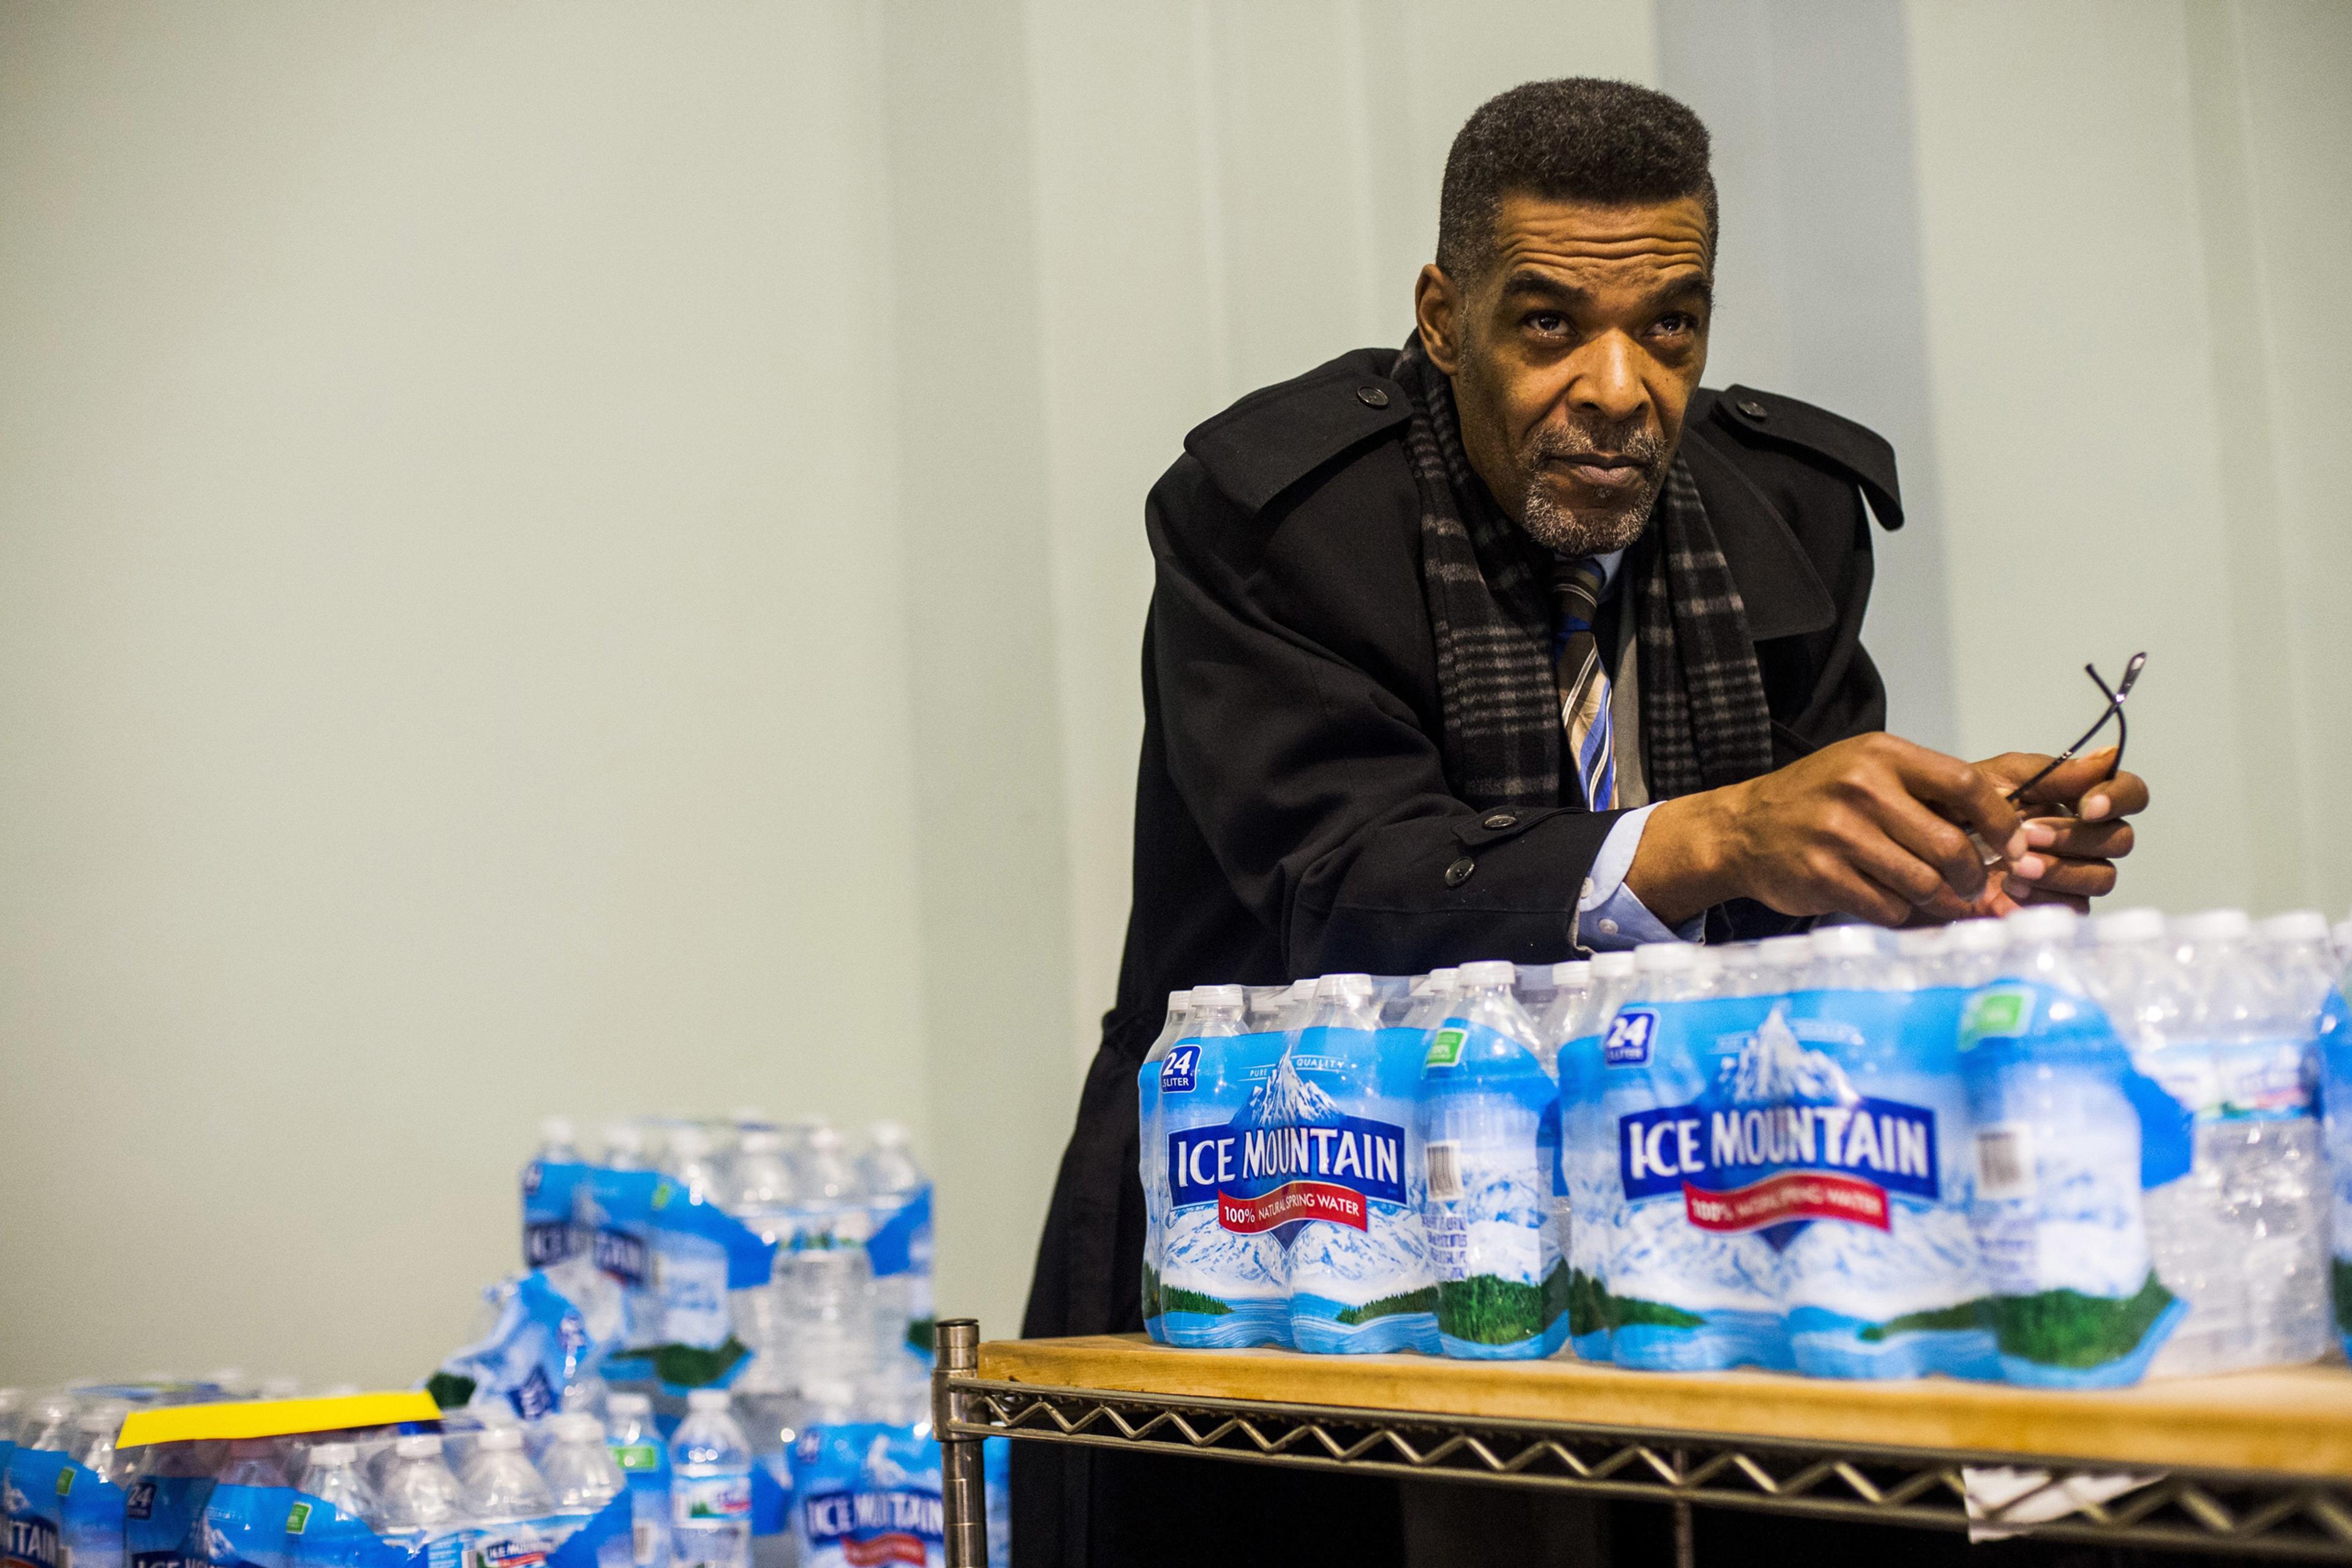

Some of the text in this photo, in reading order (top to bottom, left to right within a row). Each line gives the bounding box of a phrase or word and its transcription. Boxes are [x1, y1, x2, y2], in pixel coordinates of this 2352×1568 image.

[1607, 1016, 1649, 1048] 24
[1163, 1050, 1193, 1076] 24
[1250, 1058, 1345, 1077] PURE QUALITY
[1167, 1077, 1189, 1087] LITER
[1629, 1106, 1929, 1180] ICE MOUNTAIN
[1178, 1127, 1399, 1188] ICE MOUNTAIN
[1224, 1193, 1360, 1224] 100% NATURAL SPRING WATER
[127, 1485, 153, 1507] 24
